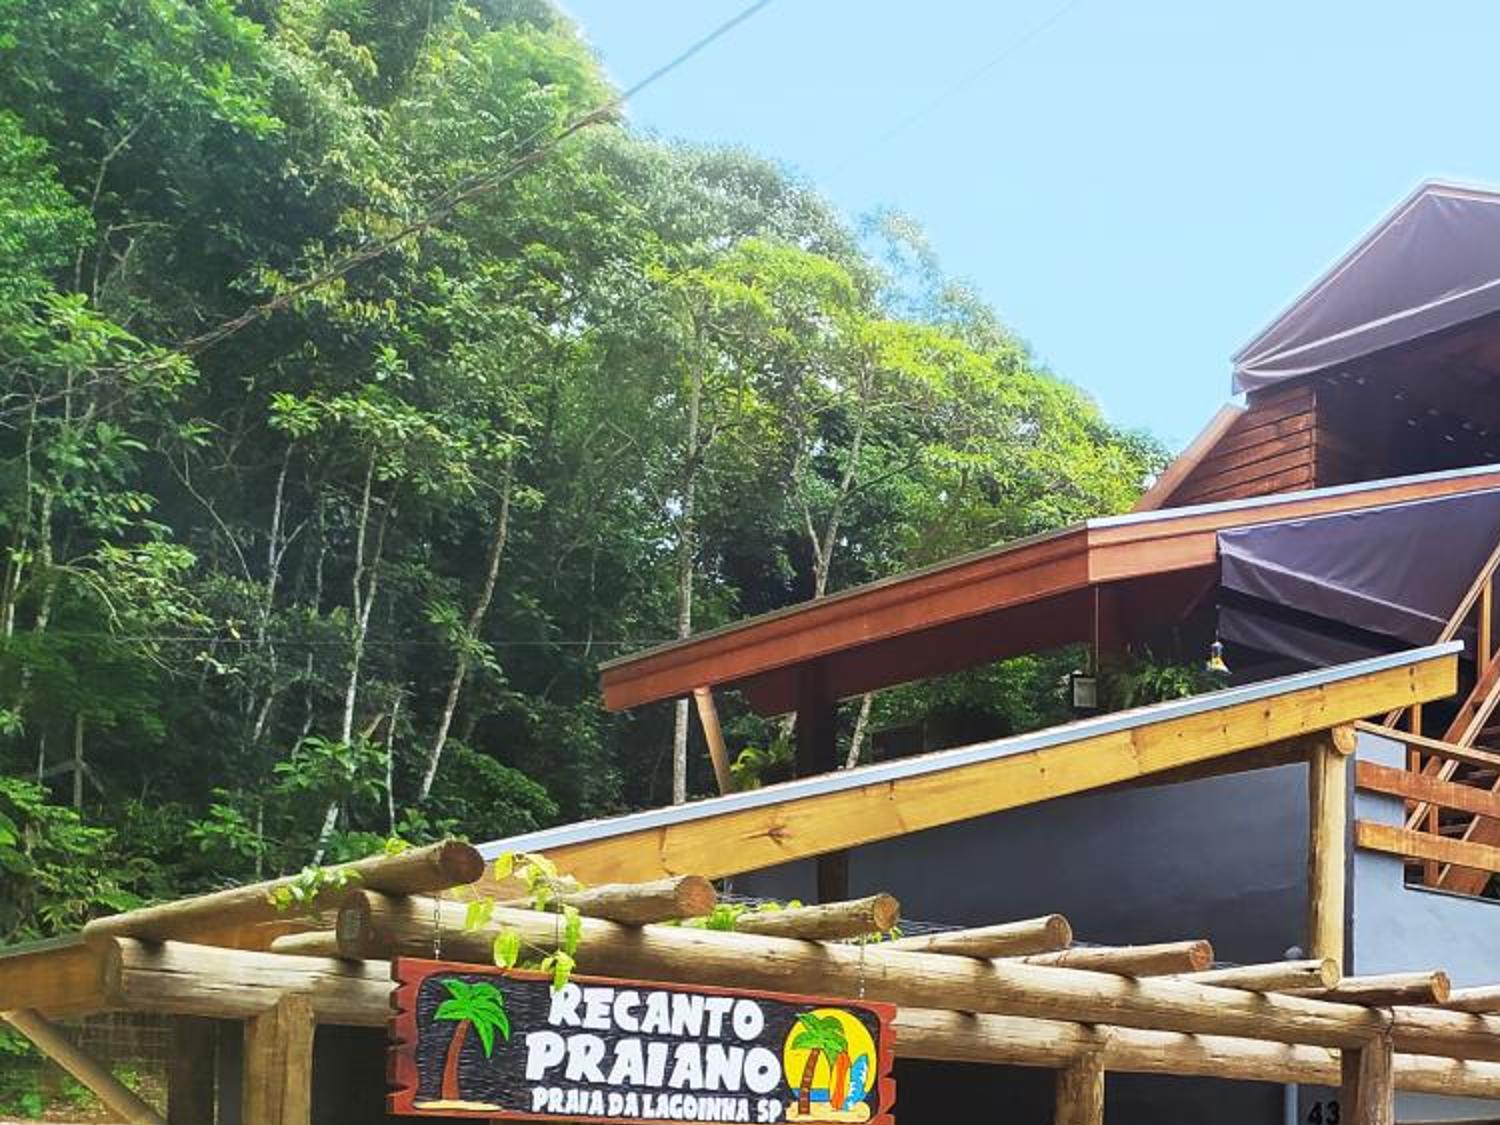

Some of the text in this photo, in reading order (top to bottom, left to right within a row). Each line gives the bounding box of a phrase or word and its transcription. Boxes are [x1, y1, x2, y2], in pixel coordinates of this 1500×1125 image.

[548, 983, 765, 1041] RECANTO
[525, 1030, 782, 1094] PRAIANO
[531, 1086, 605, 1116] PRAIA
[608, 1091, 640, 1118] DA
[757, 1099, 783, 1123] SP
